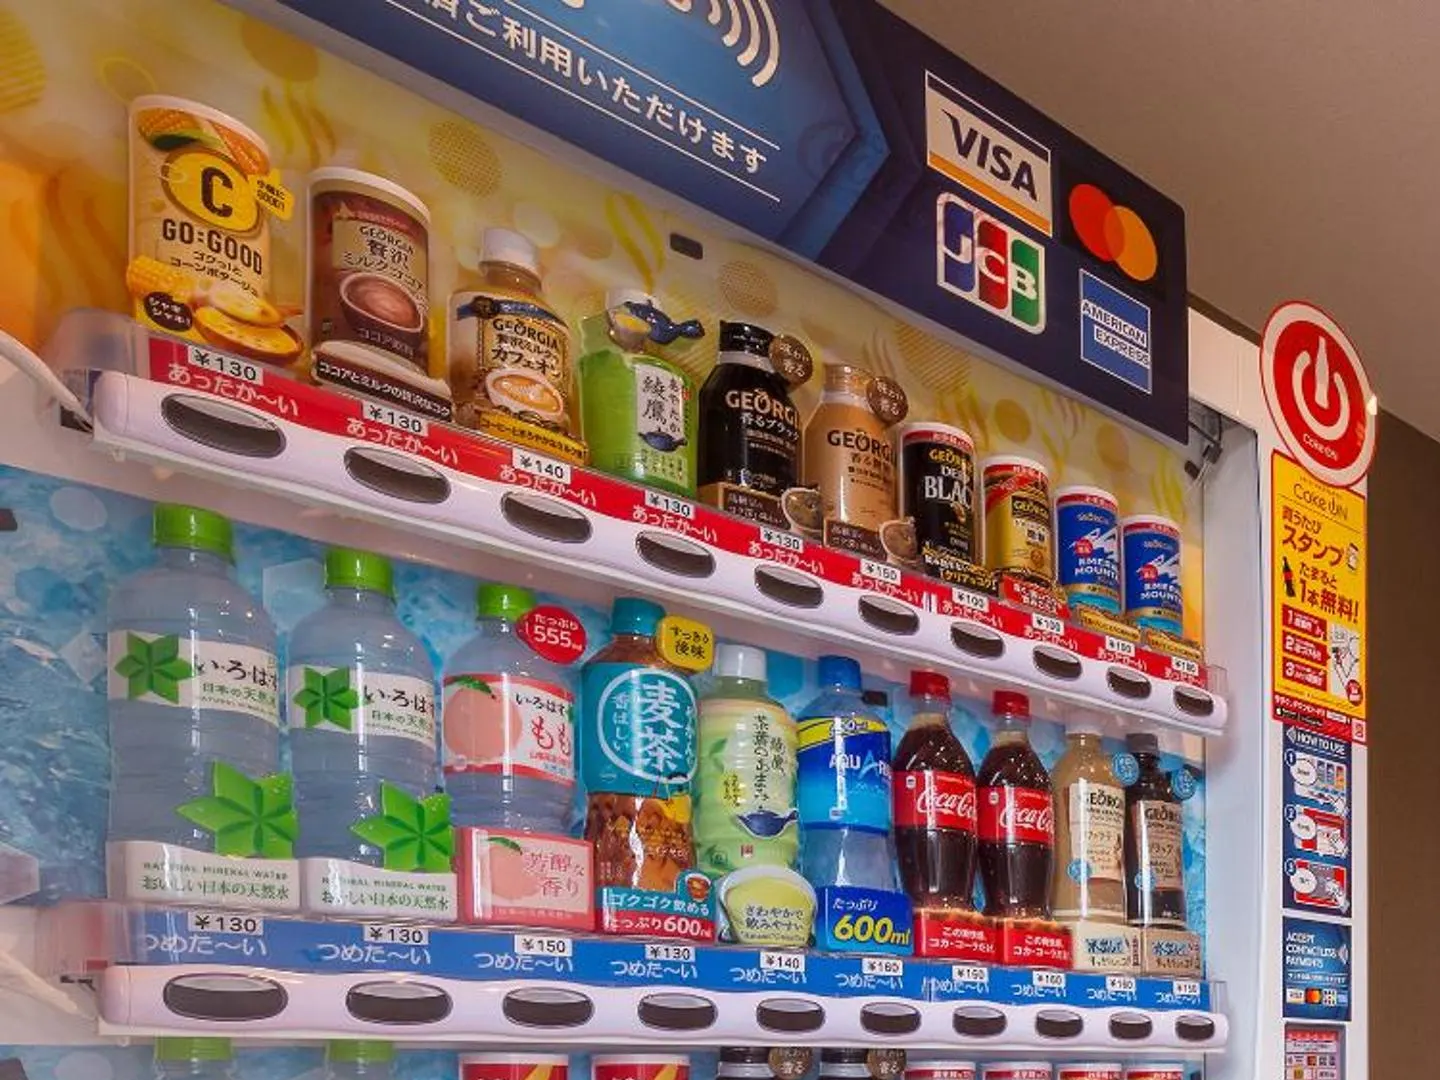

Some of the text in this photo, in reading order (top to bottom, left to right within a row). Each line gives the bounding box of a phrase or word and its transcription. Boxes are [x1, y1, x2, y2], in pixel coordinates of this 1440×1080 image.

[941, 108, 1038, 202] VISA
[201, 167, 233, 218] C
[1083, 302, 1146, 345] AMERICAN
[1096, 330, 1149, 364] EXPRESS
[194, 350, 257, 382] ¥130
[370, 404, 423, 433] ¥130
[725, 388, 799, 429] GEORGI
[519, 453, 565, 480] ¥140
[648, 495, 691, 518] ¥130
[763, 530, 801, 551] ¥130
[1282, 524, 1345, 567] スタンプ
[1299, 577, 1359, 624] 1本無料!
[638, 680, 684, 773] 麦茶
[832, 897, 879, 911] たっぷり
[195, 914, 257, 932] ¥130
[370, 926, 424, 944] ¥130
[833, 914, 911, 946] 600ml
[522, 938, 566, 954] ¥150
[649, 947, 691, 961] ¥130
[765, 955, 800, 970] ¥140
